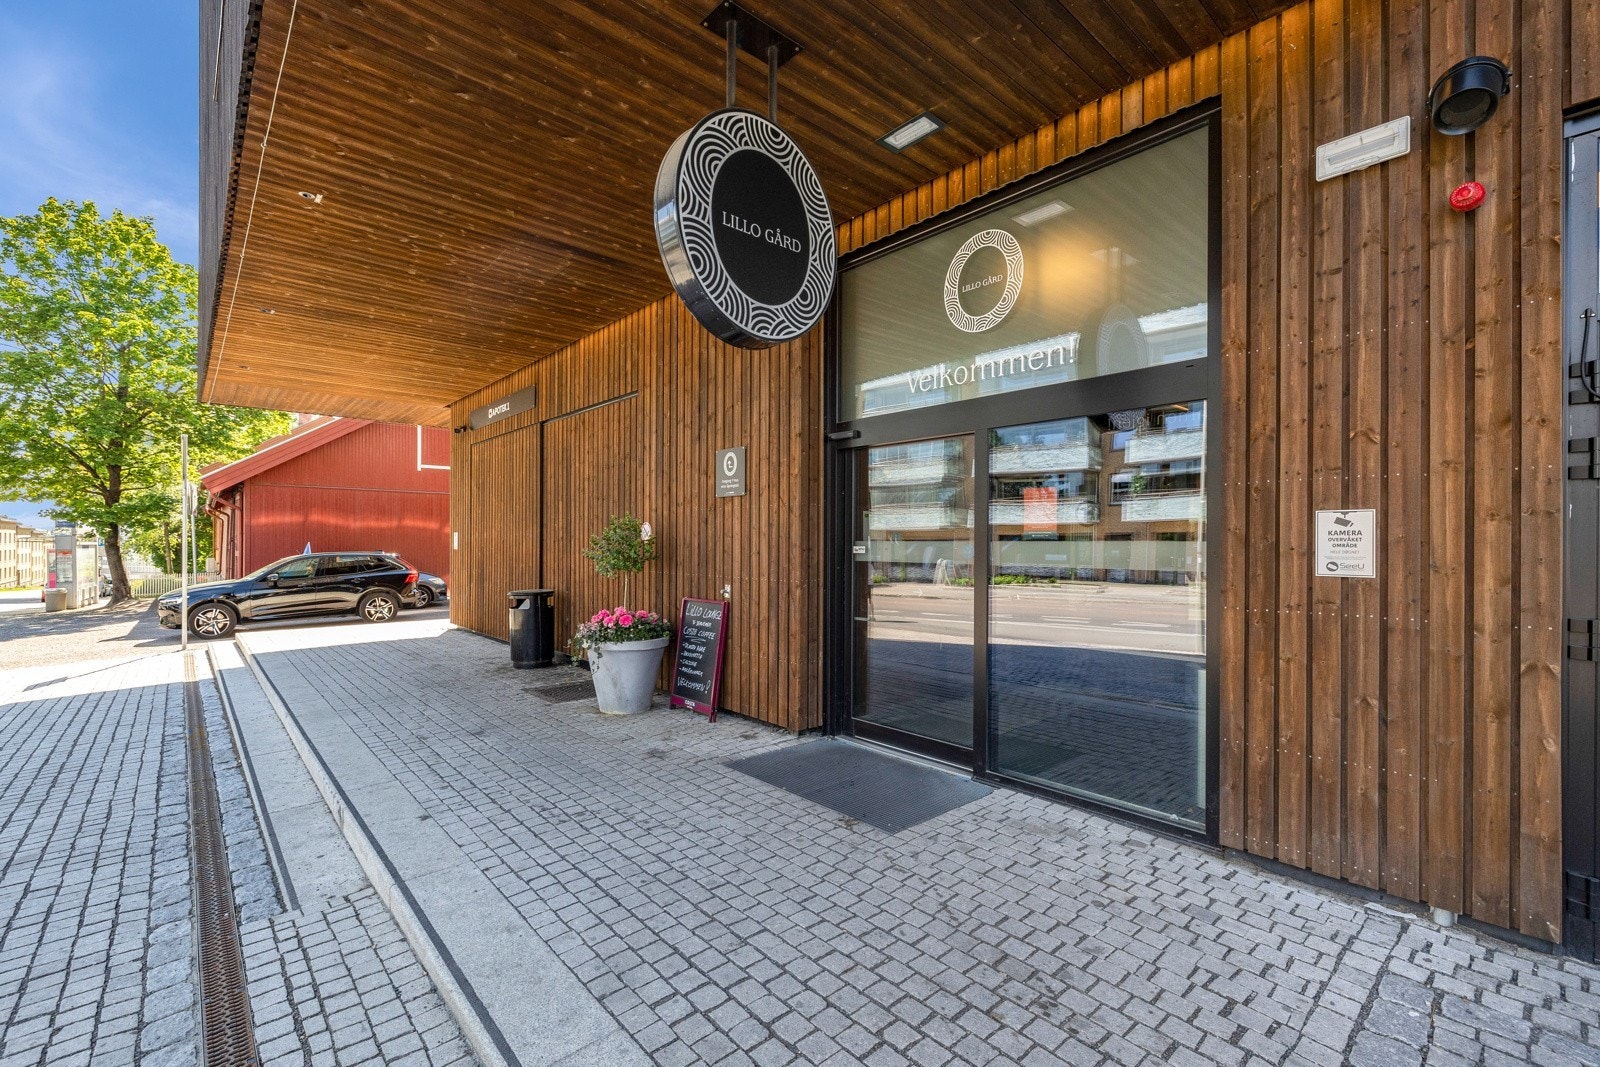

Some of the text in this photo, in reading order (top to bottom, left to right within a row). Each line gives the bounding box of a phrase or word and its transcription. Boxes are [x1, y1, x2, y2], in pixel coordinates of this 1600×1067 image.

[722, 211, 802, 253] LILLO GÅRD
[962, 274, 1003, 293] LILLO GÅRD
[907, 336, 1076, 393] Velkommen!
